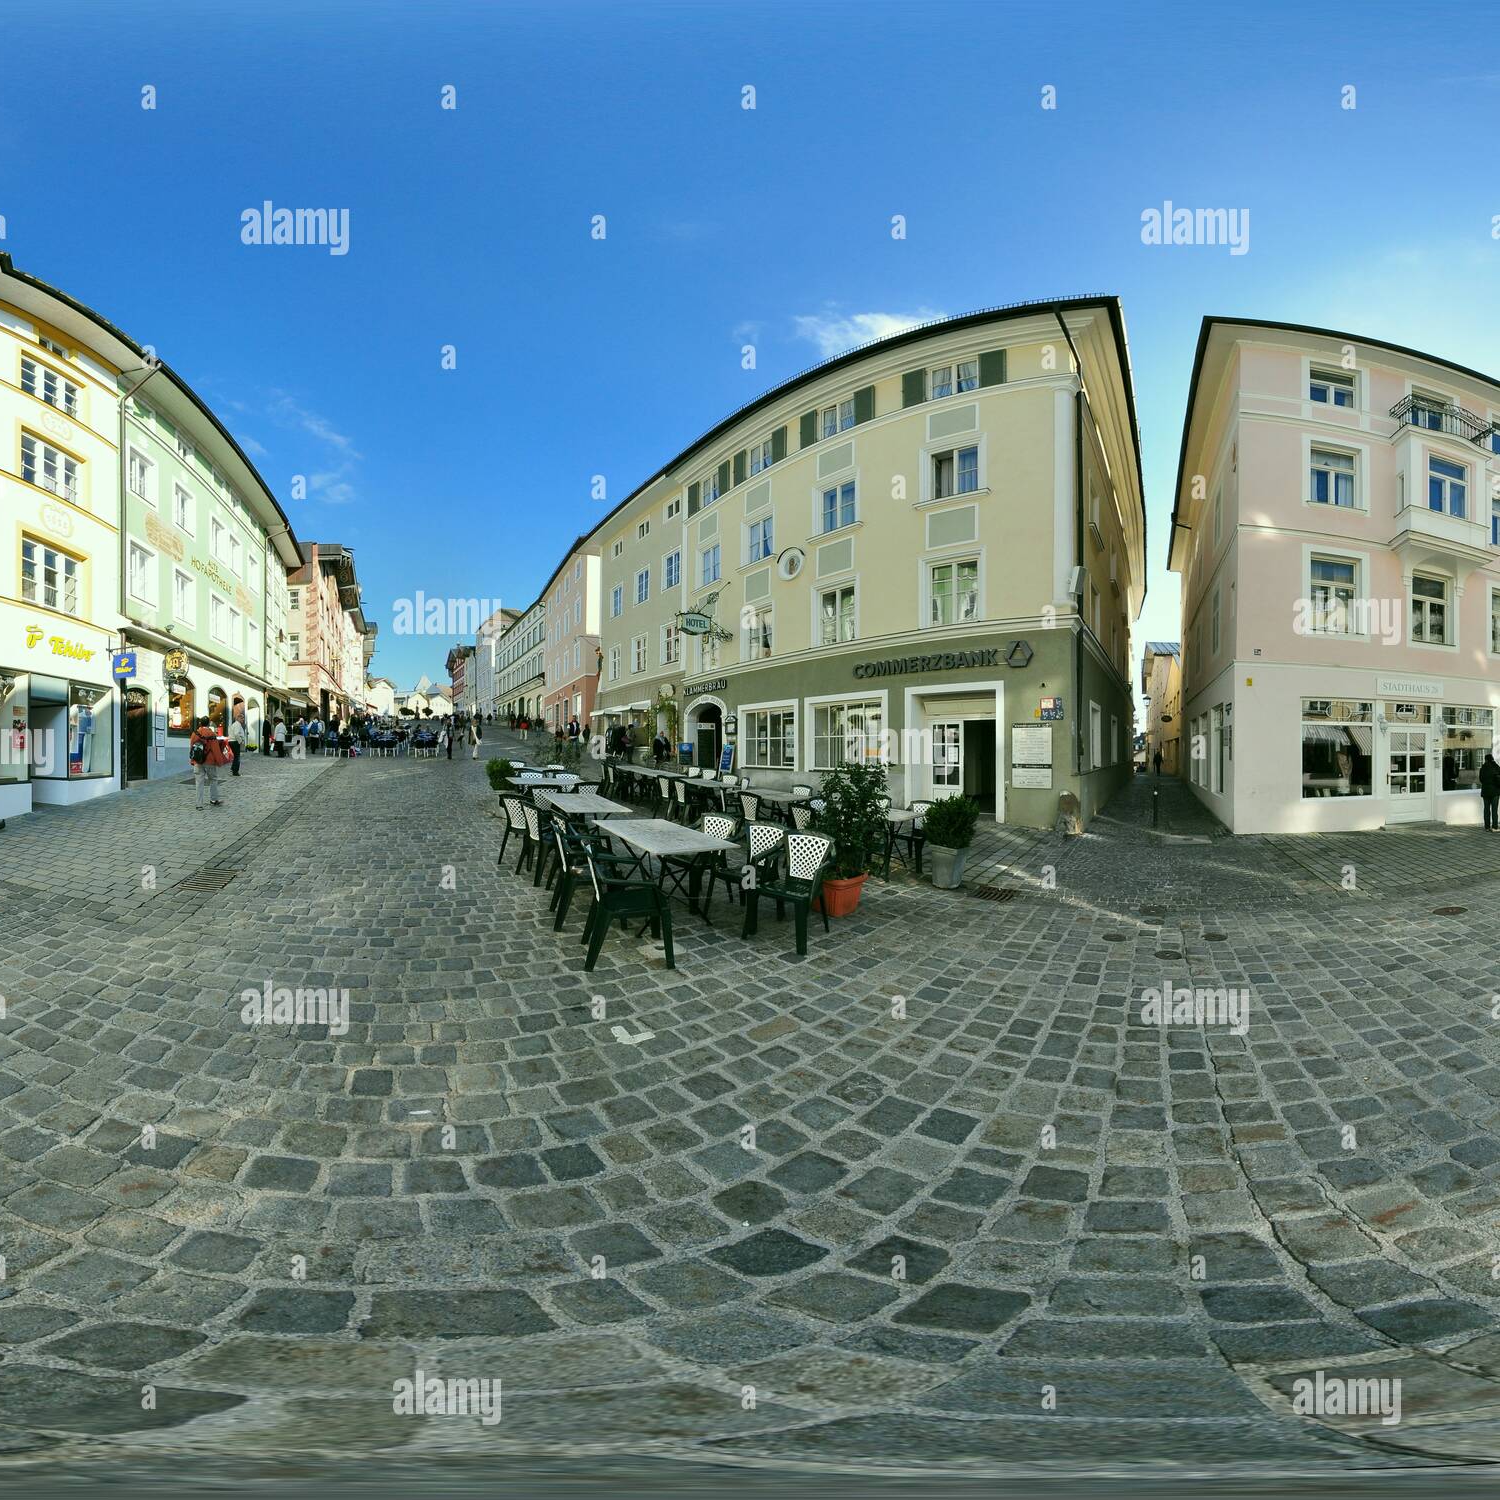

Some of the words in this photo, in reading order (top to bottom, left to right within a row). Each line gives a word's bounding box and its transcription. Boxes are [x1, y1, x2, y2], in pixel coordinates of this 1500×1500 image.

[190, 555, 232, 595] HOFAPOTHEKE
[685, 618, 708, 629] HOTEL
[49, 636, 96, 662] Tchibo
[853, 648, 998, 679] COMMERZBANK
[1382, 681, 1430, 693] STADTHAUS
